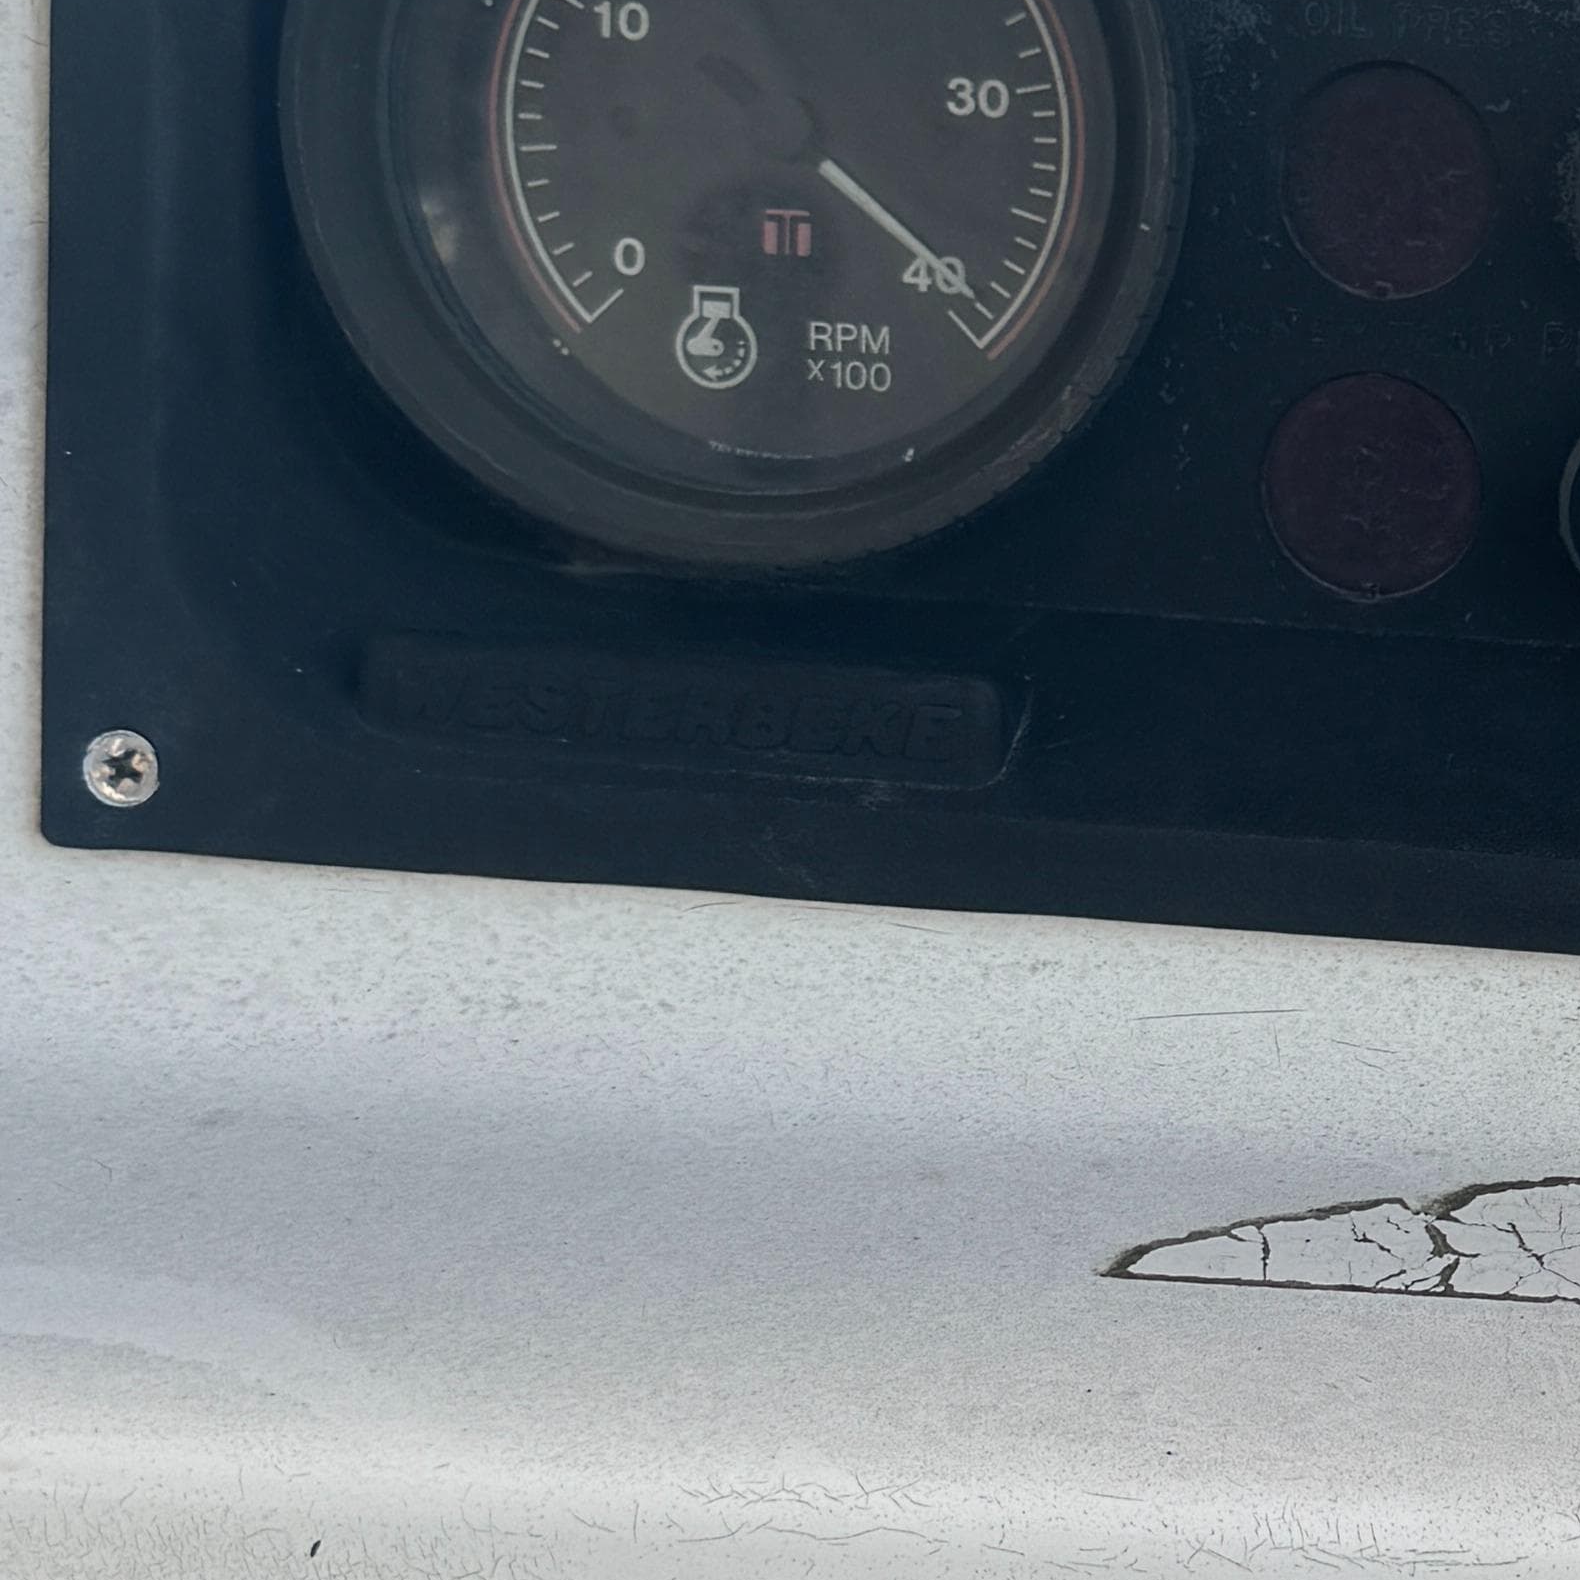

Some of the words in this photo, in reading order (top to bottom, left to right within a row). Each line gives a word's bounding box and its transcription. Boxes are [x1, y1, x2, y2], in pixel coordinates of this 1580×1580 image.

[594, 2, 650, 41] 10
[946, 79, 1010, 119] 30
[614, 238, 645, 275] 0
[902, 256, 966, 294] 40
[809, 323, 891, 355] RPM
